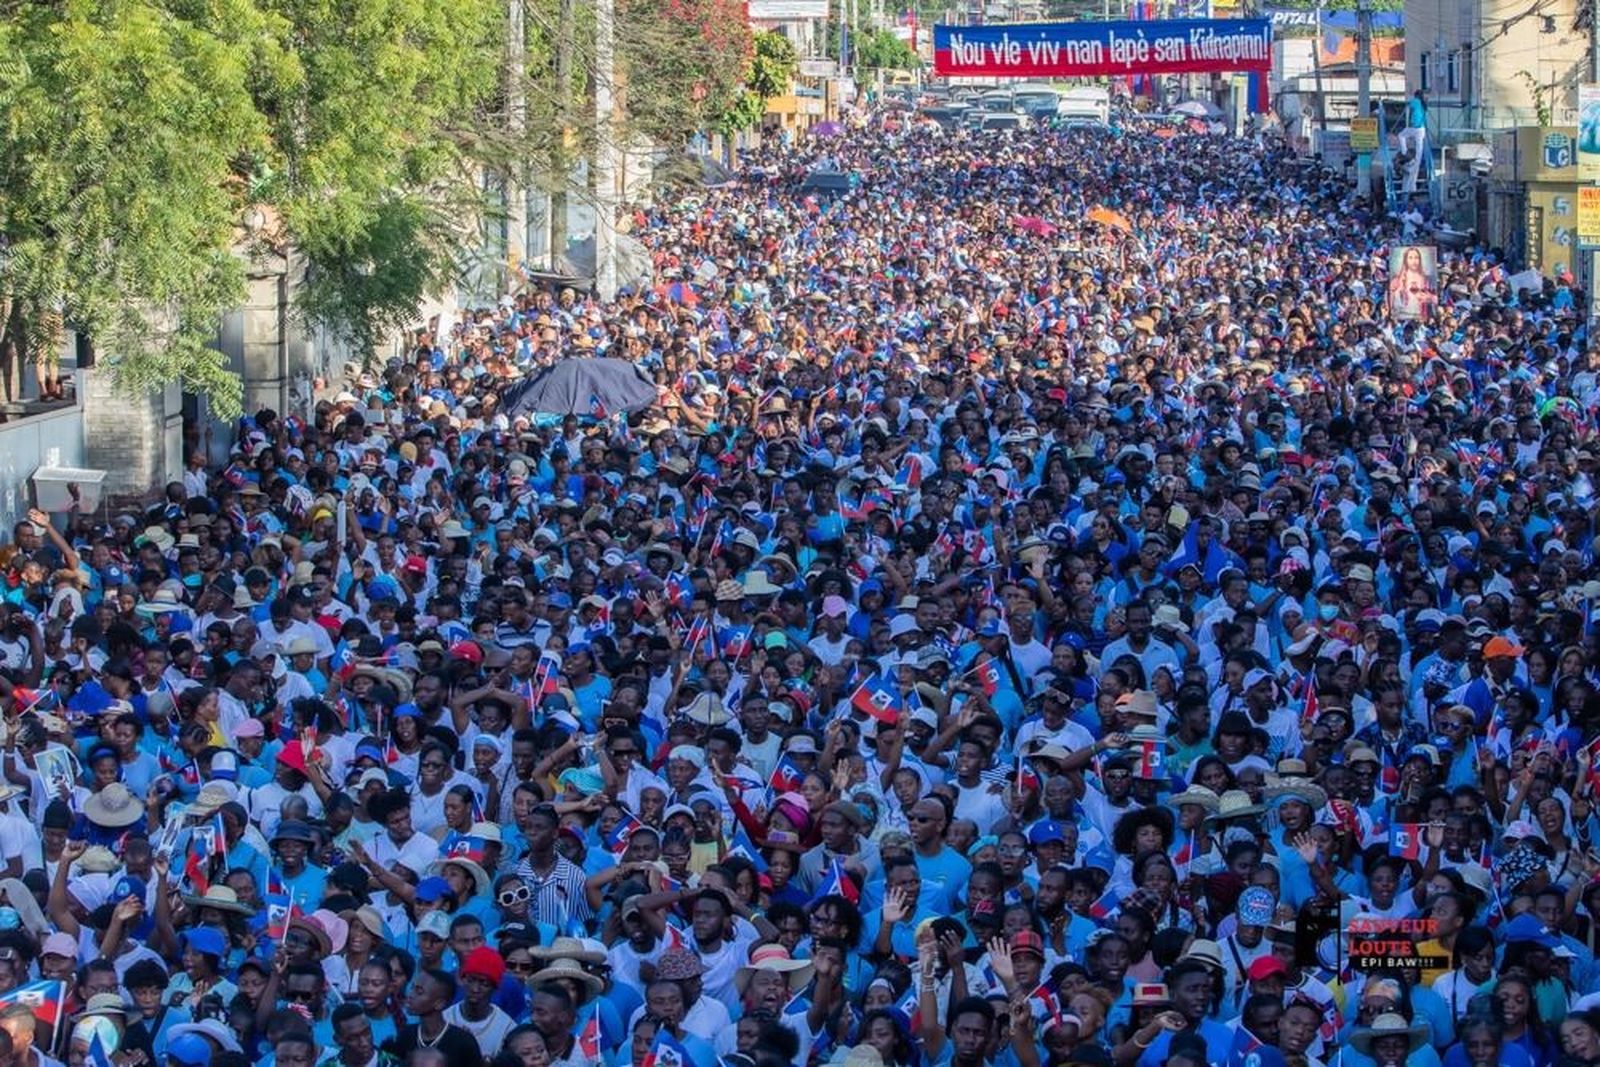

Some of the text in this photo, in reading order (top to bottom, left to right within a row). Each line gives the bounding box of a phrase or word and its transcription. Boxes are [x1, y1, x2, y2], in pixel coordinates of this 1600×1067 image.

[950, 33, 986, 66] Nou
[991, 32, 1021, 65] vle
[1028, 32, 1060, 65] viv
[1067, 39, 1103, 65] nan
[1154, 36, 1186, 62] san
[1190, 26, 1269, 64] Kidnapinn!
